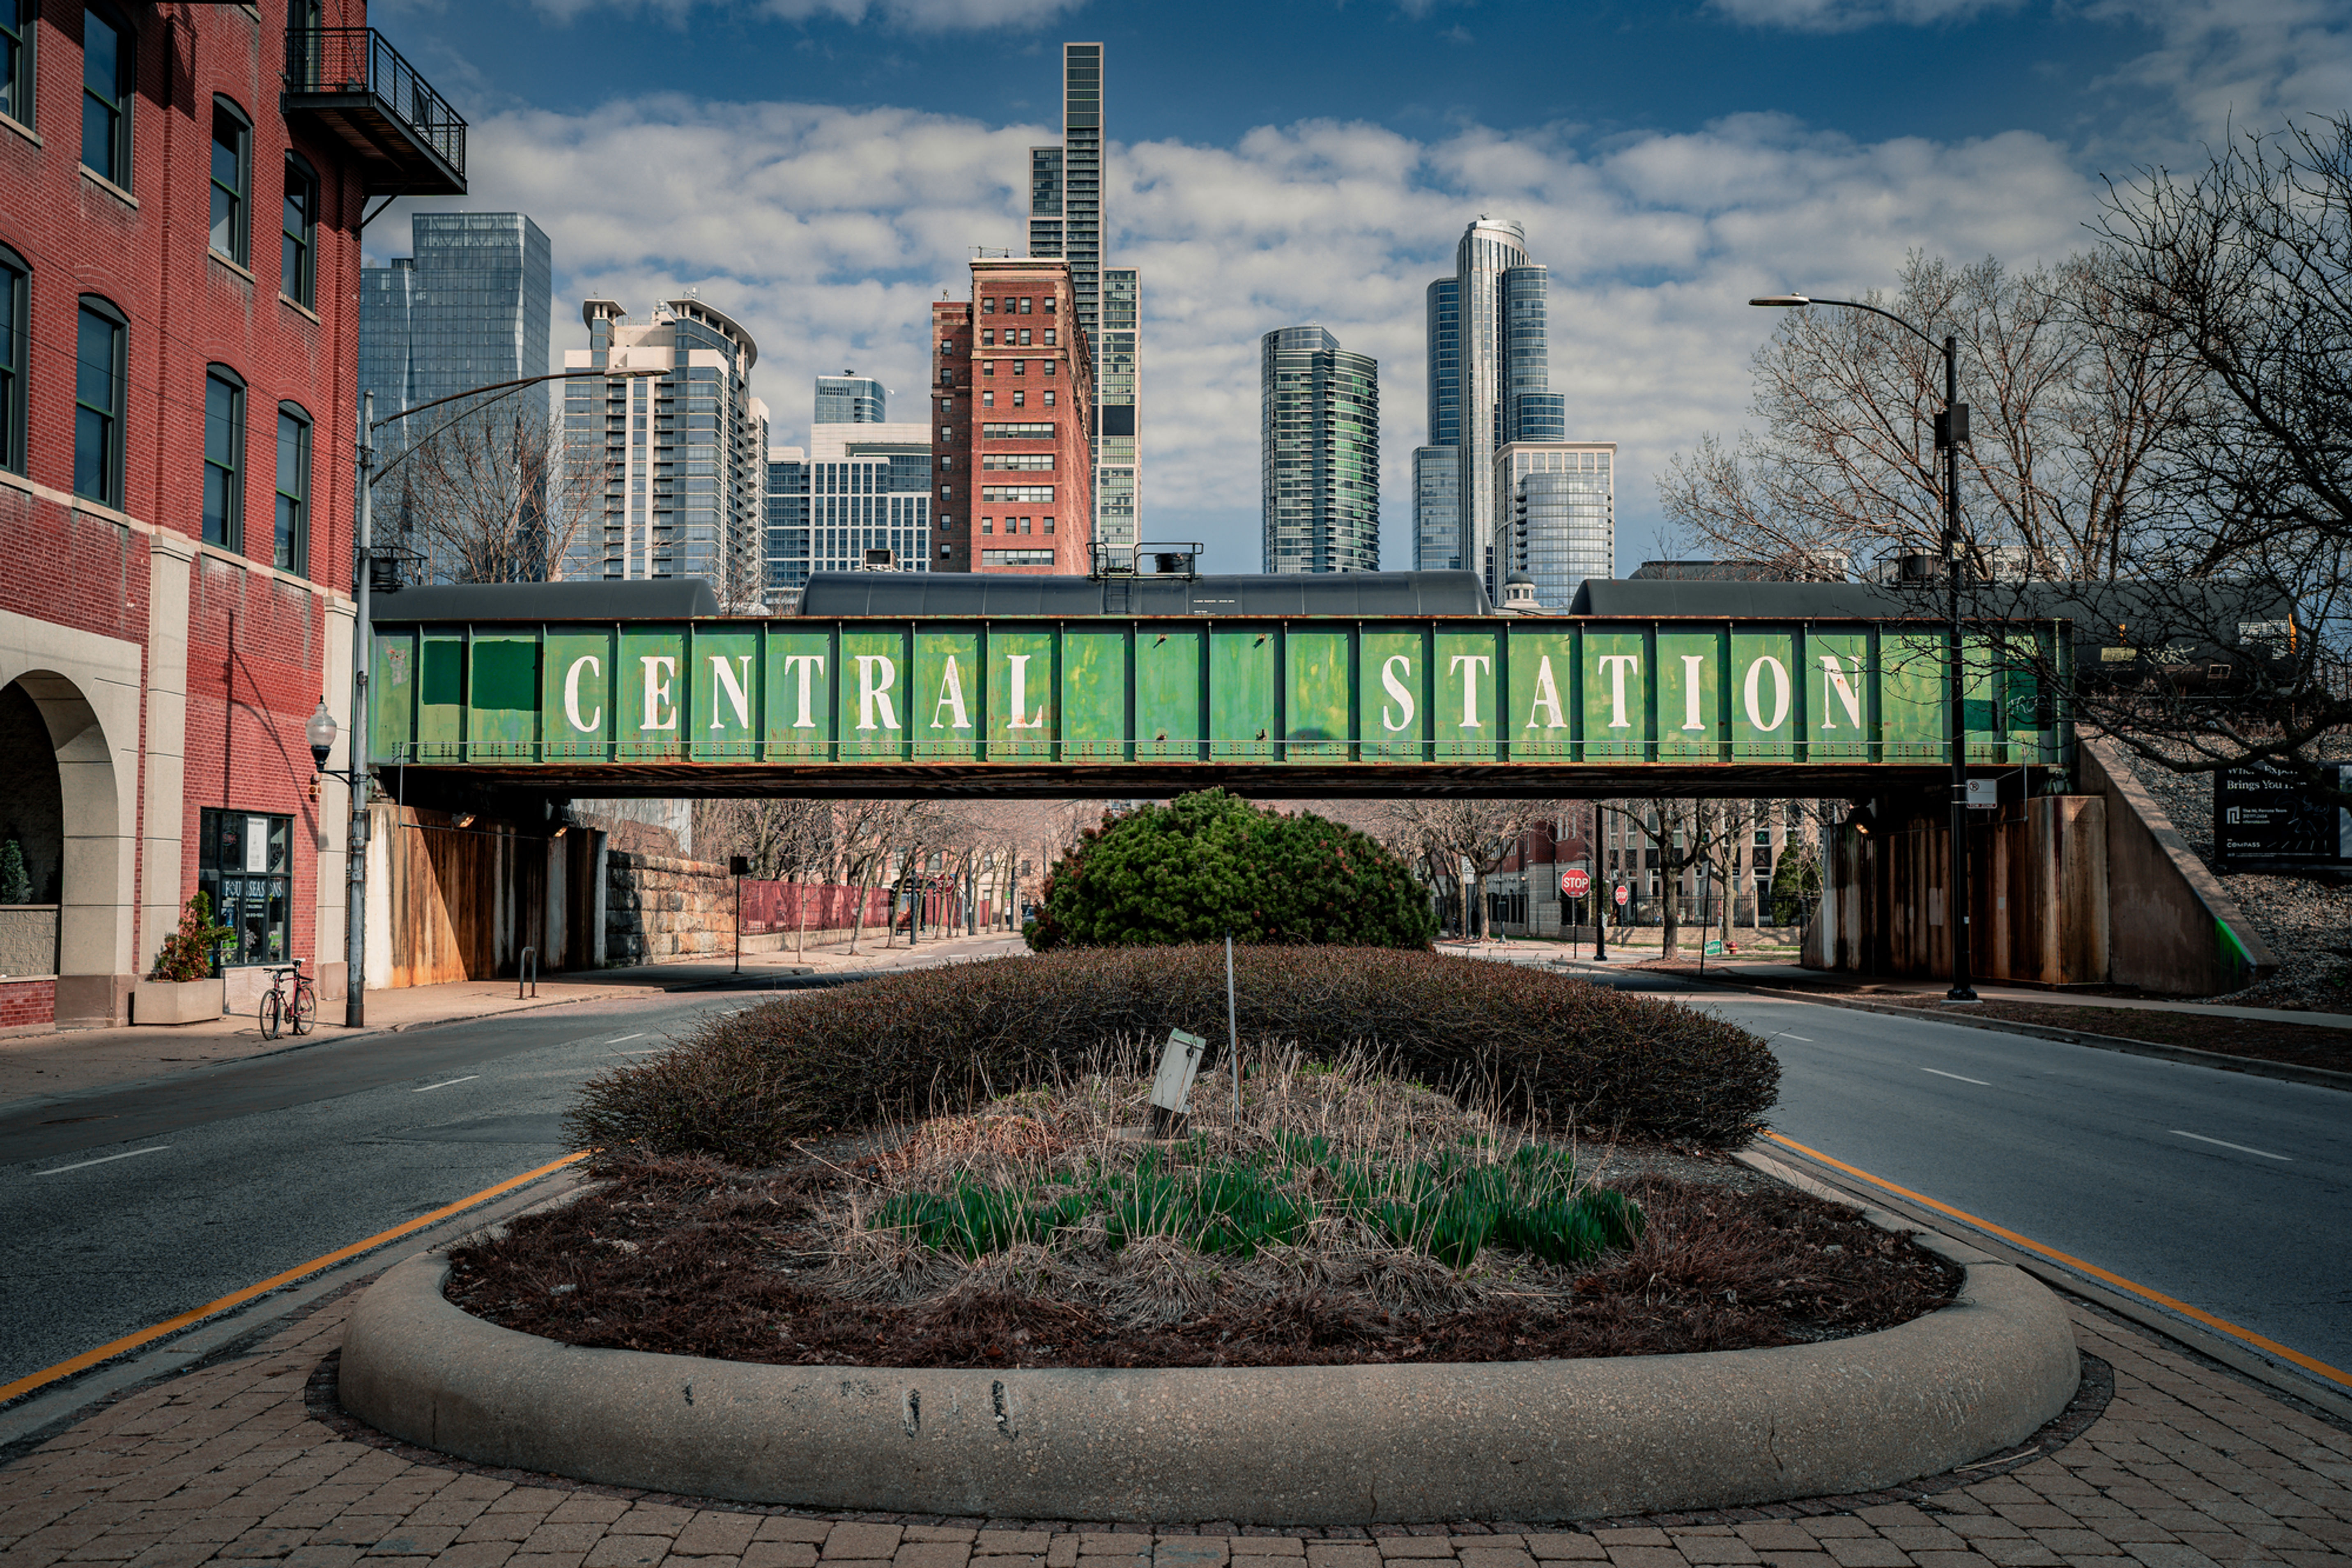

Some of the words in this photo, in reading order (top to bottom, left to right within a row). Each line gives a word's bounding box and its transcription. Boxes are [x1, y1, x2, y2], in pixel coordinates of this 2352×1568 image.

[564, 655, 1043, 732] CENTRAL
[1381, 655, 1861, 732] STATION
[2227, 780, 2260, 791] Brings
[2262, 780, 2282, 789] You
[938, 879, 953, 887] SP
[1563, 878, 1588, 888] STOP
[225, 881, 249, 897] FOU
